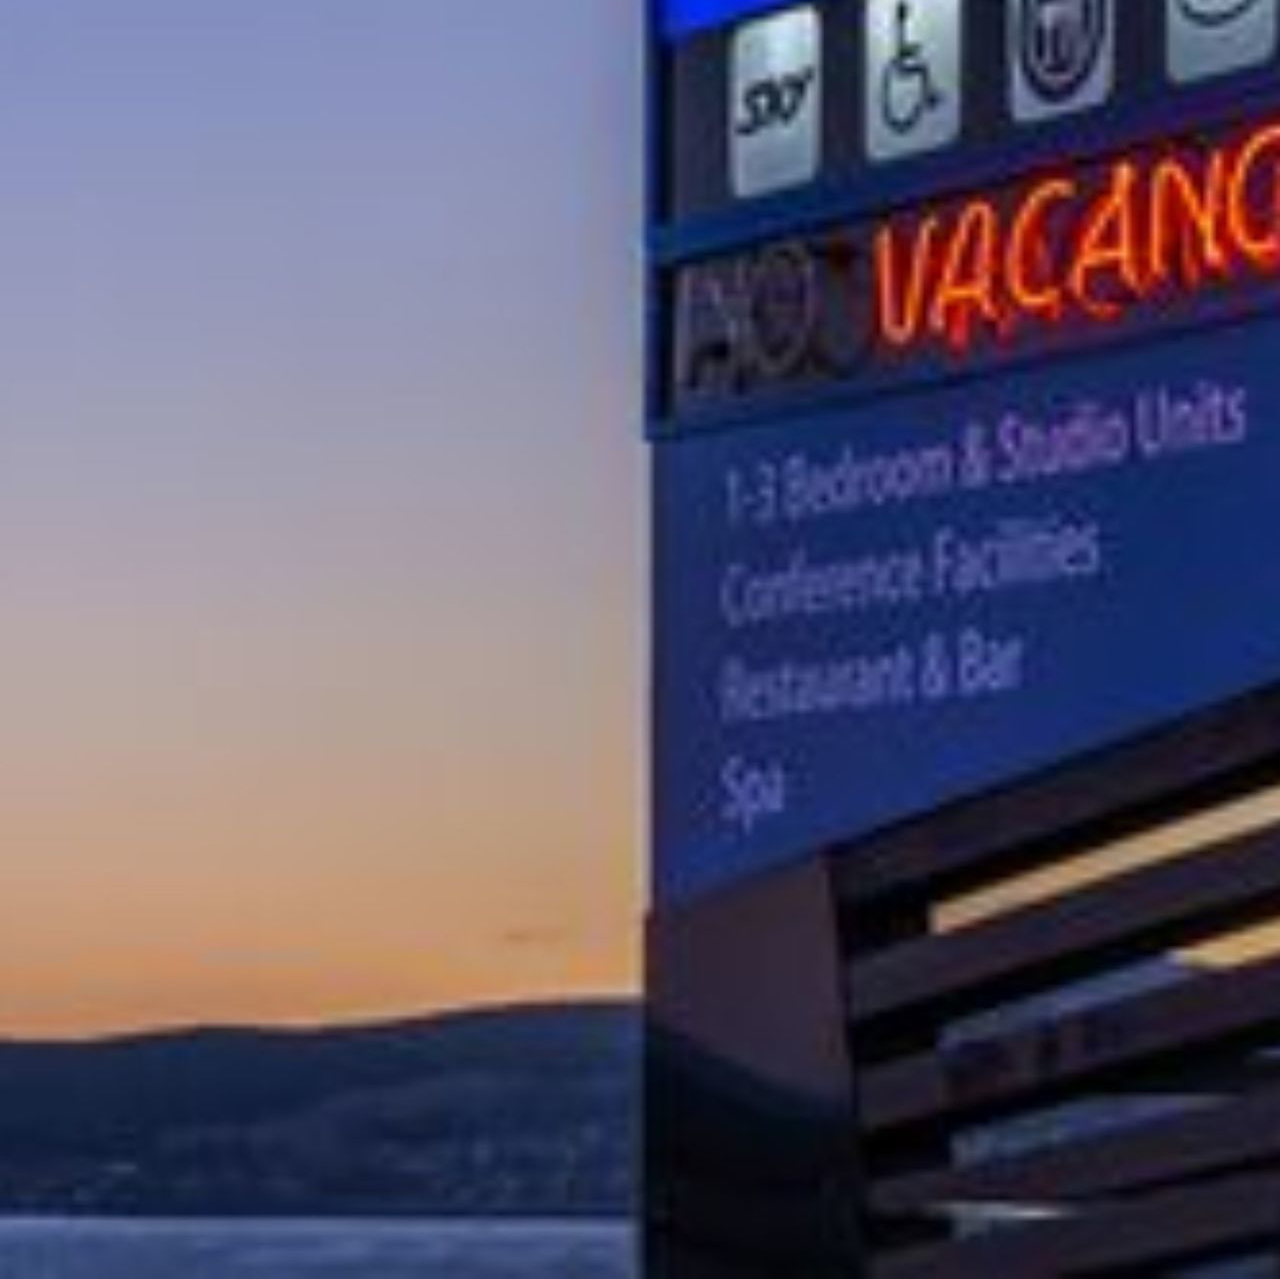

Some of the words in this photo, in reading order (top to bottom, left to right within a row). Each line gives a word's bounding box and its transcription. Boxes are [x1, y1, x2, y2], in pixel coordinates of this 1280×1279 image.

[781, 444, 953, 518] Bedroom
[960, 426, 992, 487] &
[996, 404, 1129, 482] Studio
[1134, 382, 1247, 457] Units
[720, 545, 921, 622] Conference
[933, 522, 1099, 596] Facilities
[721, 640, 915, 720] Restaurant
[920, 634, 952, 700] &
[957, 630, 1023, 694] Bar
[720, 756, 785, 828] Spa
